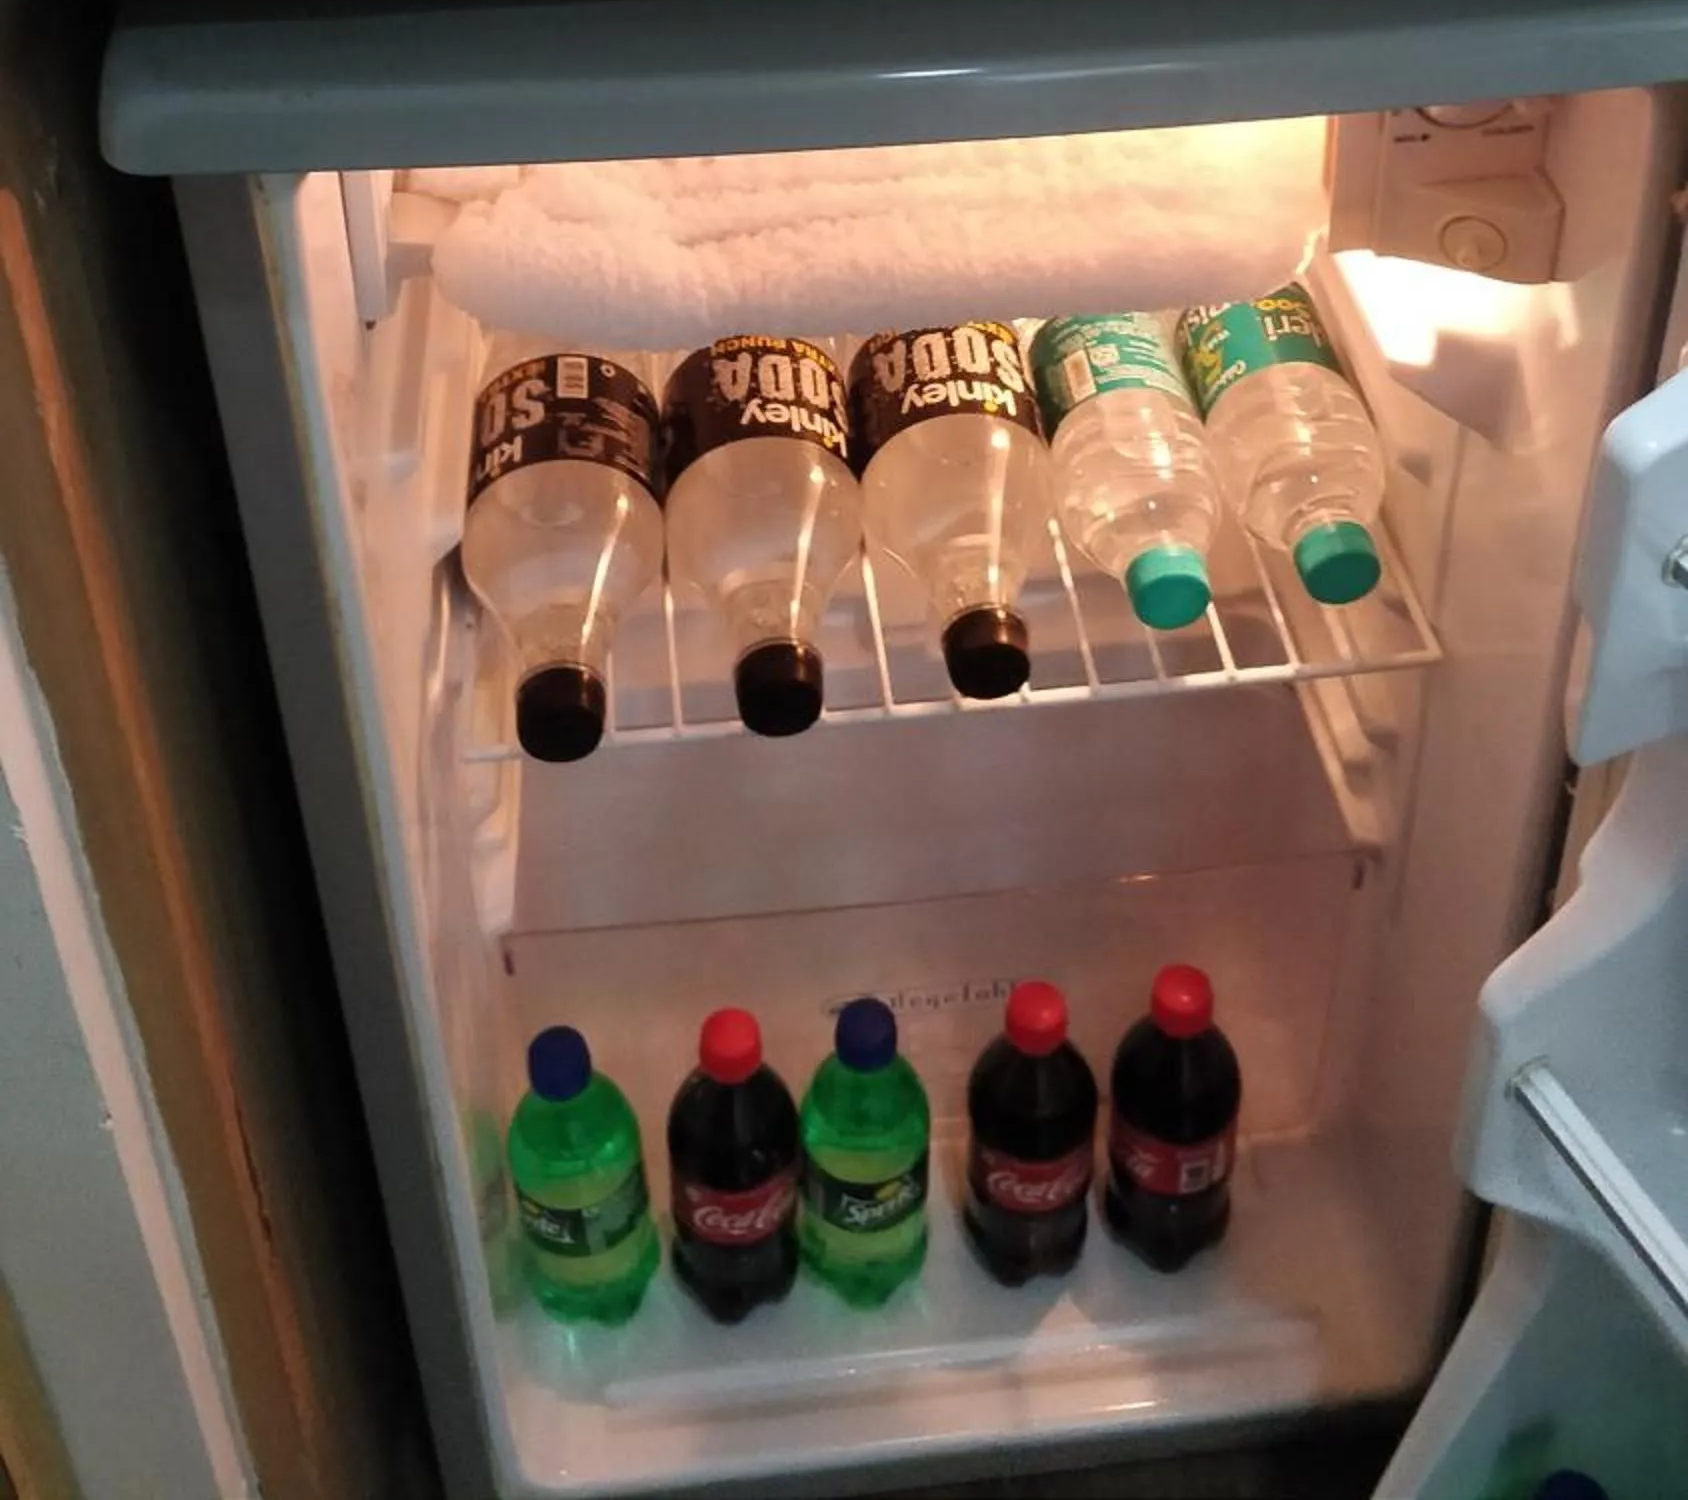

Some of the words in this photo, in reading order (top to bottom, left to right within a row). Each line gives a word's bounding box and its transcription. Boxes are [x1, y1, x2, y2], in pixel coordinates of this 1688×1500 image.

[872, 326, 1025, 393] SODA
[740, 398, 848, 458] kinley
[900, 379, 1017, 417] kinley
